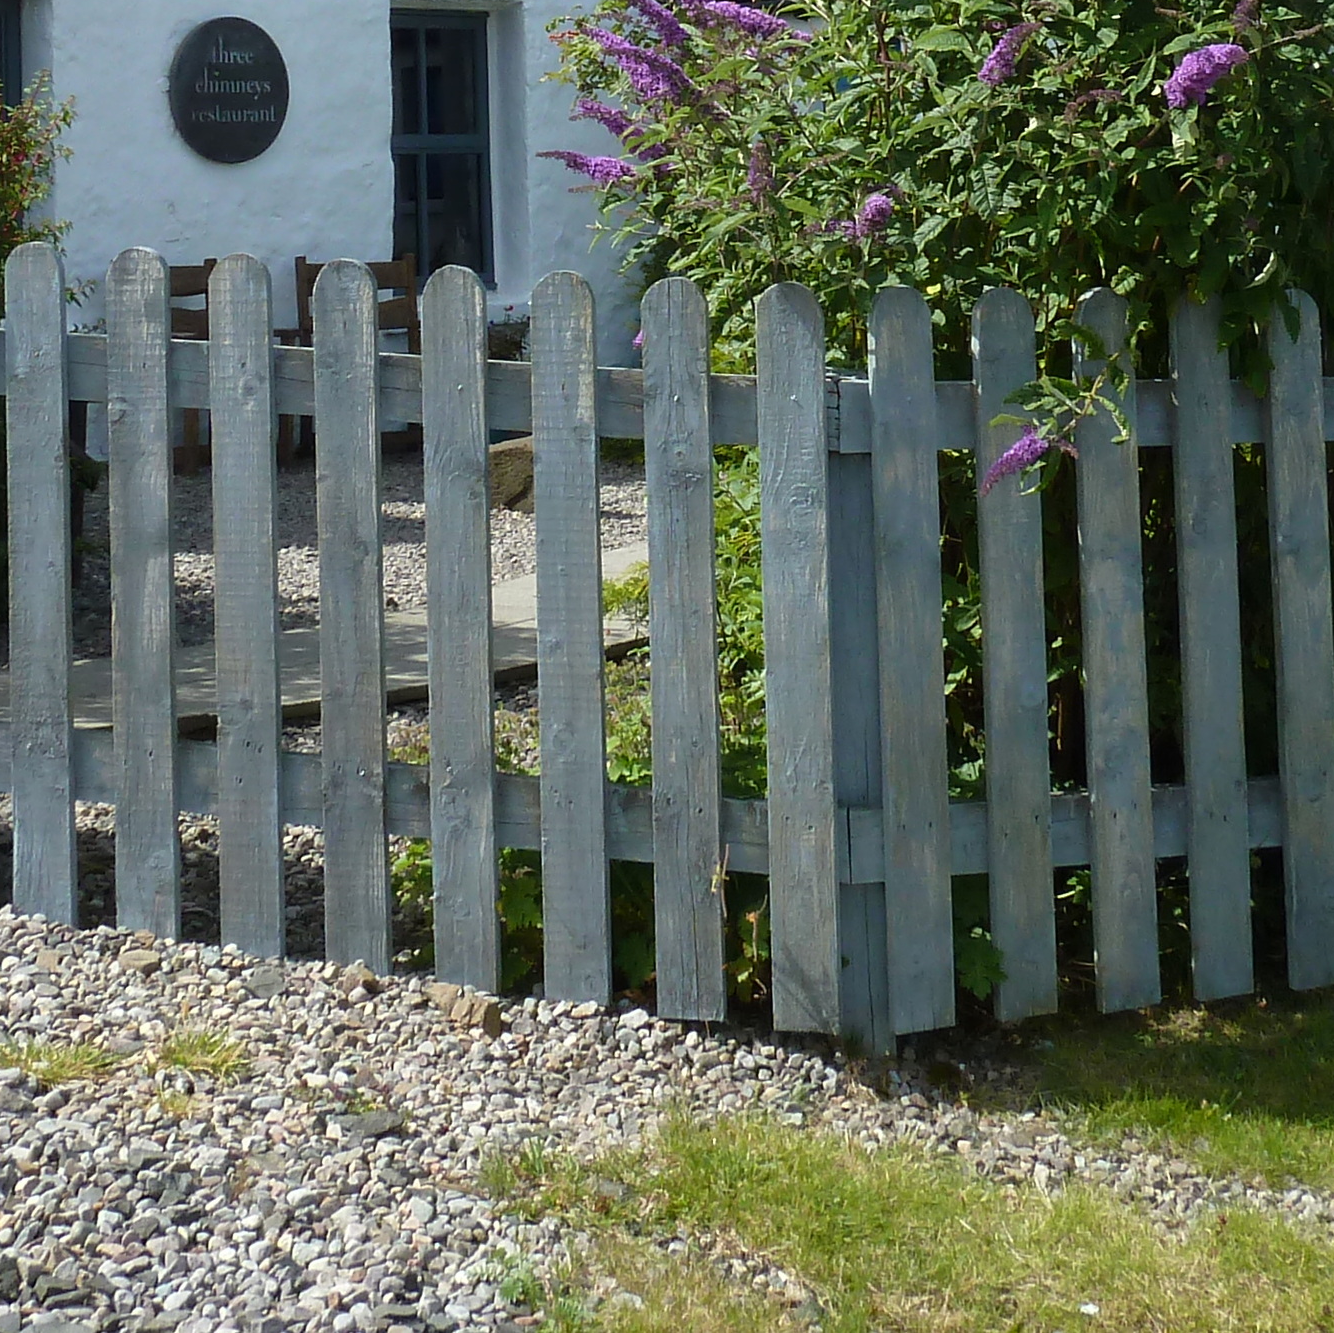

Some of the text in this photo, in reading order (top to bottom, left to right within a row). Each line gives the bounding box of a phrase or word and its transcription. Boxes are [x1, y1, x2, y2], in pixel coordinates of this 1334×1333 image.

[212, 34, 254, 63] three
[195, 66, 271, 100] chimneys
[191, 105, 277, 122] restaurant
